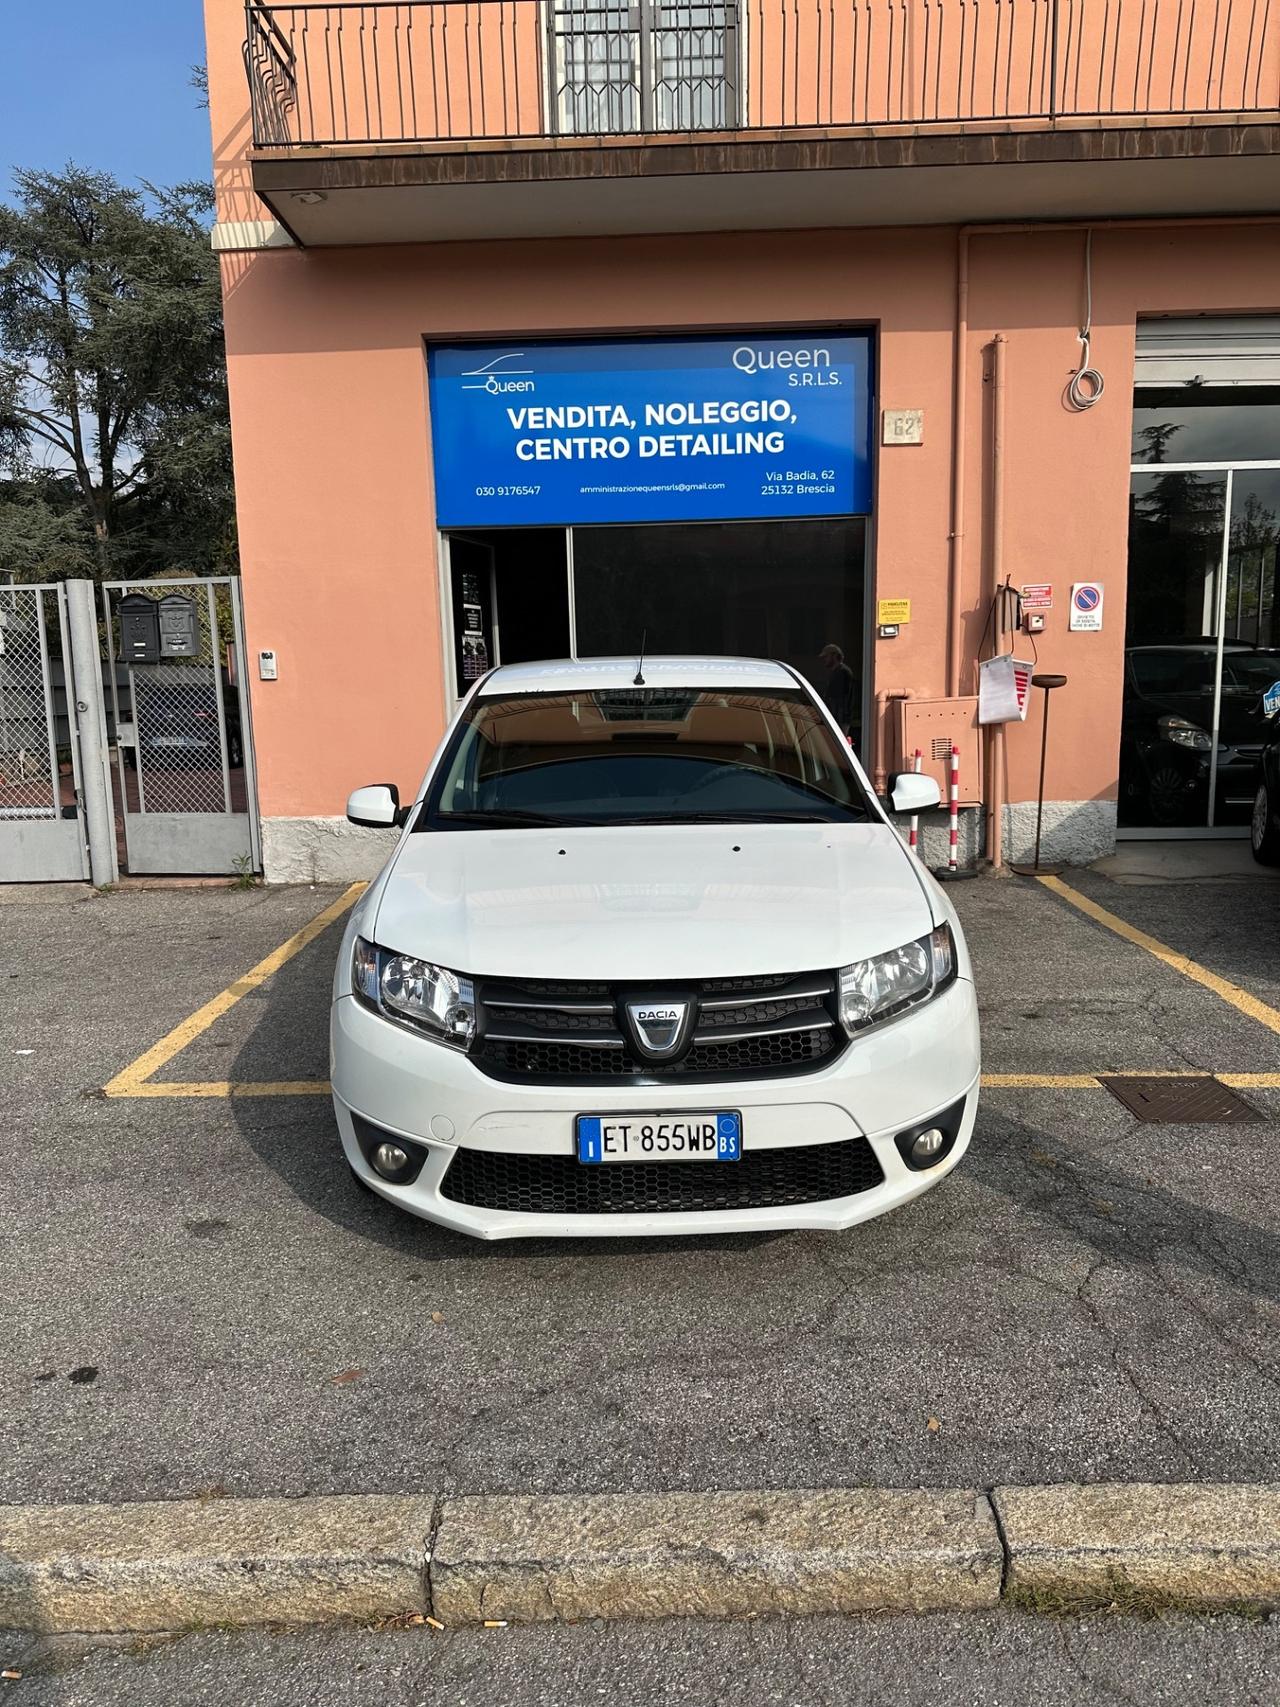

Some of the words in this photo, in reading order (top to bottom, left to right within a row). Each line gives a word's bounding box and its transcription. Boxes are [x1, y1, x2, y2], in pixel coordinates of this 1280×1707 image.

[732, 347, 830, 374] Queen
[485, 377, 535, 395] Queen
[788, 372, 842, 386] S.R.L.S.
[507, 405, 636, 429] VENDITA,
[645, 400, 797, 425] NOLEGGIO,
[516, 437, 630, 461] CENTRO
[639, 432, 785, 458] DETAILING
[766, 472, 783, 481] Via
[786, 470, 819, 481] Badia,
[821, 470, 835, 480] 62
[476, 487, 495, 496] 030
[497, 486, 541, 496] 9176547
[580, 482, 726, 494] amministrazionequeensrls@gmail.com
[761, 485, 793, 495] 25132
[797, 484, 835, 494] Brescia
[638, 1011, 677, 1019] DACIA
[603, 1126, 632, 1152] ET
[641, 1124, 716, 1152] 855WB
[719, 1137, 736, 1153] BS
